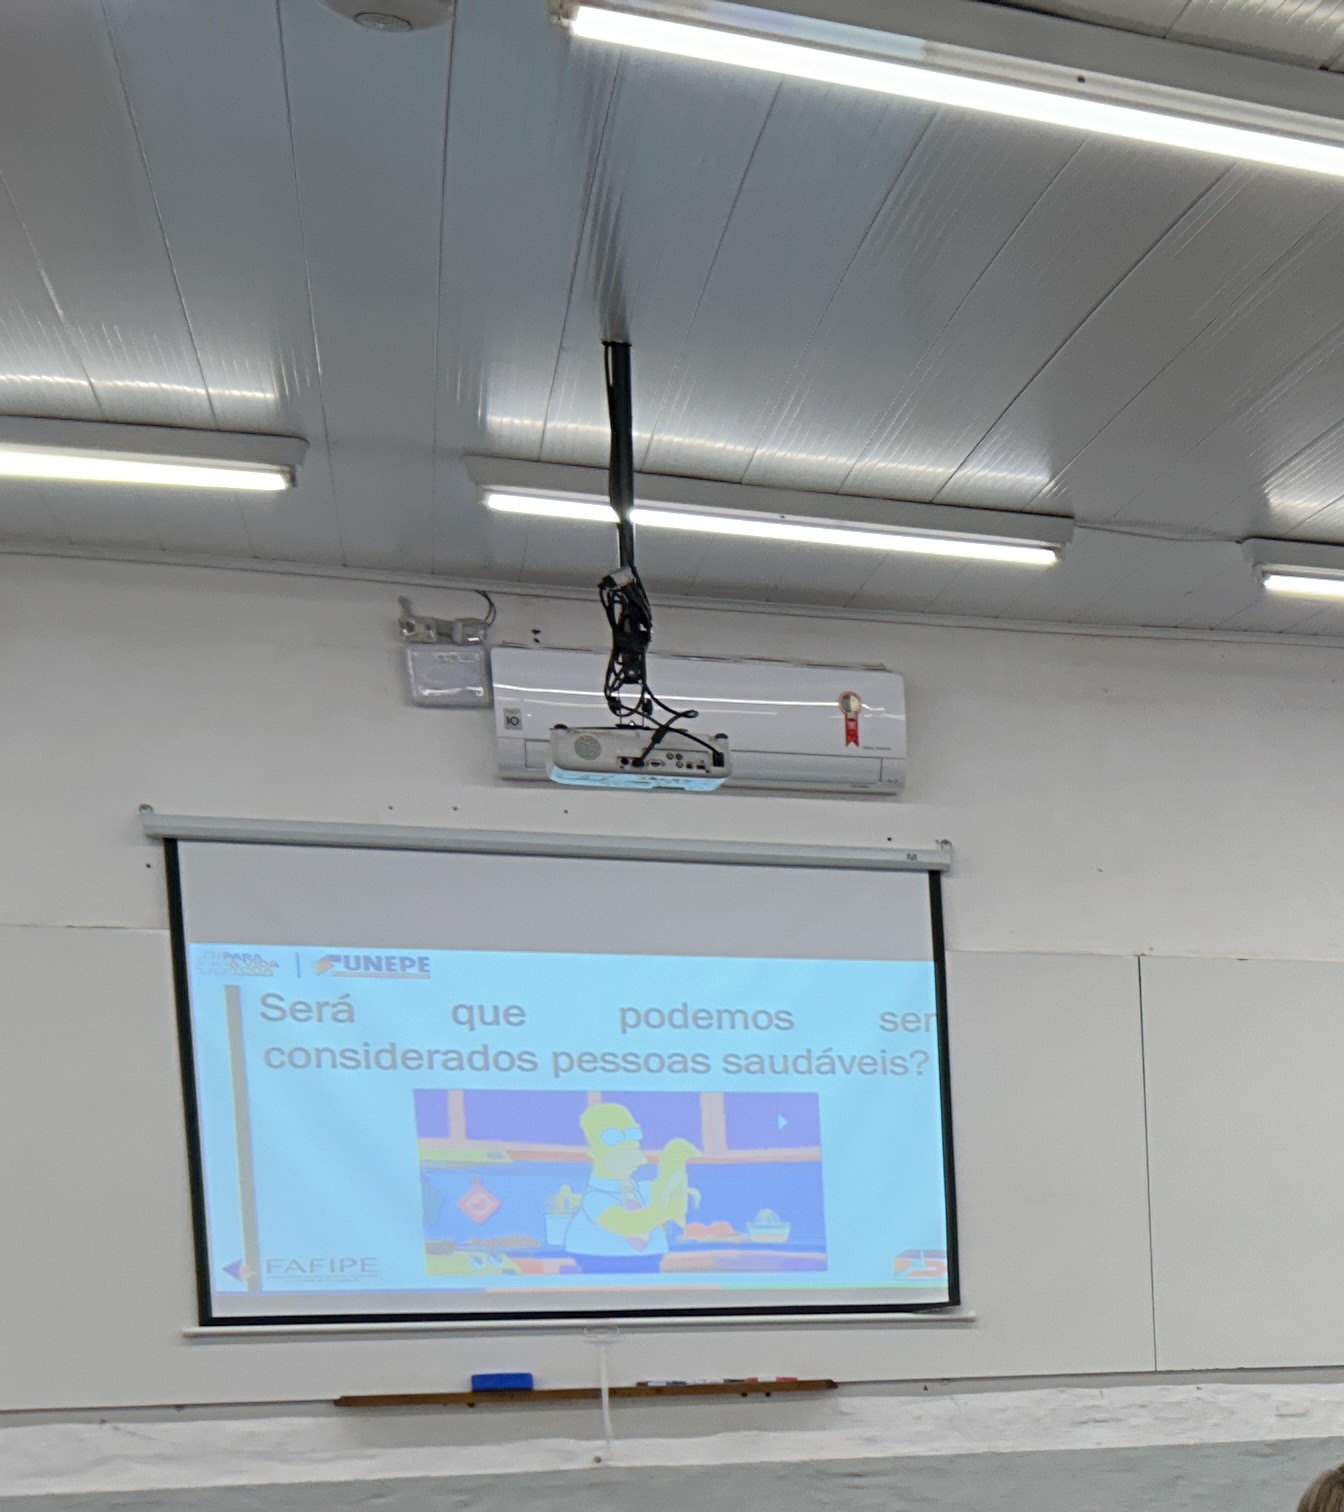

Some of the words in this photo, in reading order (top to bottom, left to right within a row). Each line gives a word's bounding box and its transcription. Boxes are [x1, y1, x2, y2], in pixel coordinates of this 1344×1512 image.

[259, 993, 355, 1023] Será
[451, 1003, 527, 1031] que
[619, 1003, 795, 1034] podemos
[879, 1010, 938, 1032] ser
[263, 1042, 539, 1072] considerados
[552, 1049, 711, 1078] pessoas
[721, 1047, 931, 1076] saudáveis?
[265, 1257, 378, 1274] FAFIPE
